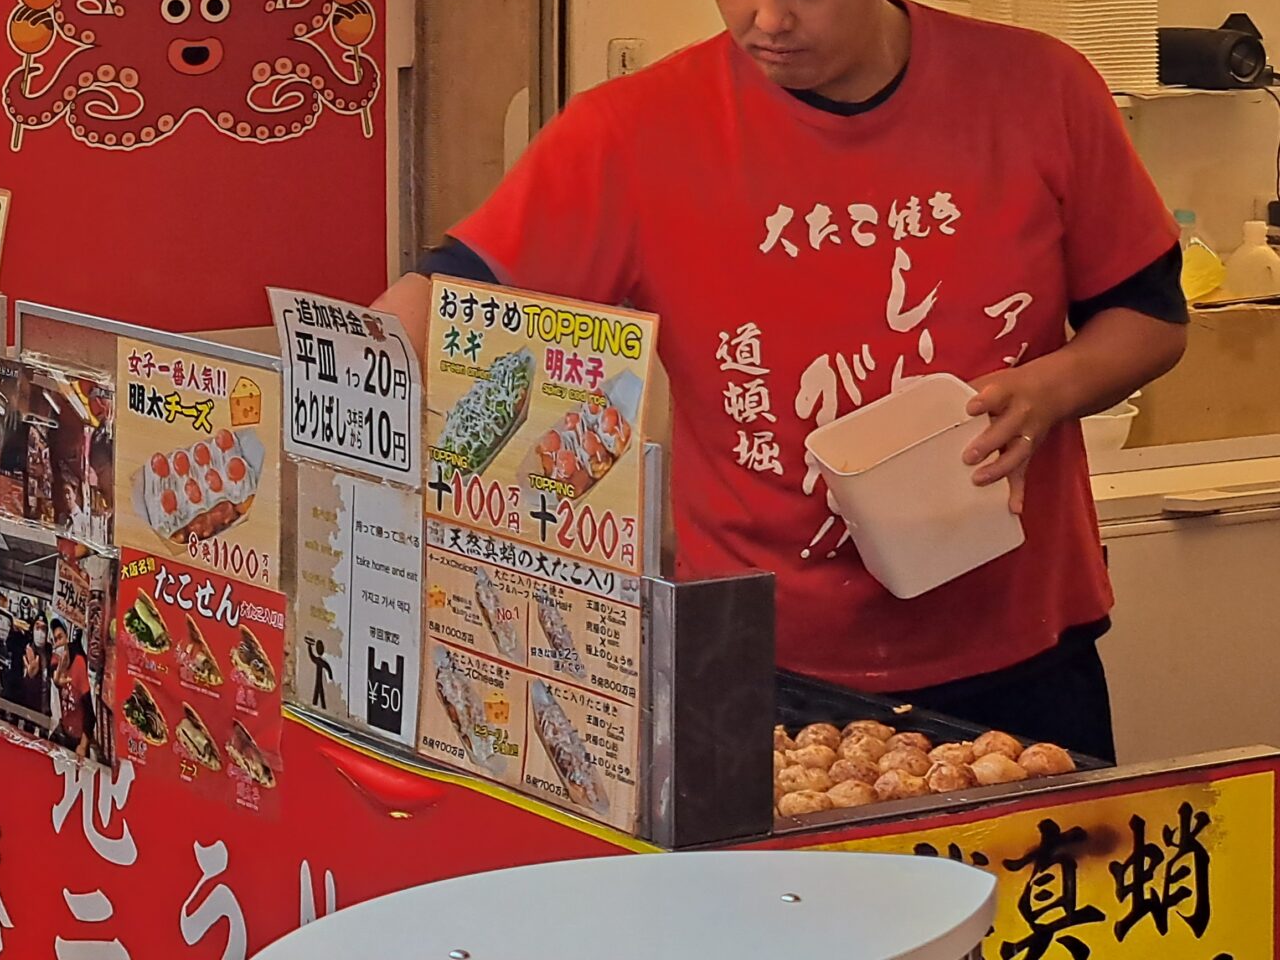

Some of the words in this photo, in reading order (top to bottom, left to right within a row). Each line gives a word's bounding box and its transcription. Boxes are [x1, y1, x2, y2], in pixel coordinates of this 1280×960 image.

[758, 191, 962, 258] 大たこ焼き
[294, 298, 366, 337] 追加料金
[439, 288, 521, 332] おすすめ
[523, 304, 643, 359] TOPPING
[295, 331, 338, 384] 平皿
[364, 347, 407, 400] 20円
[443, 325, 483, 363] ネギ
[545, 347, 605, 389] 明太子
[128, 349, 227, 395] 女子一番人気!!
[128, 383, 214, 434] 明太チーズ
[715, 321, 784, 476] 道頓堀
[295, 388, 346, 446] わりばし
[365, 407, 406, 463] 10円
[429, 445, 468, 469] TOPPING
[528, 473, 575, 498] TOPPING
[356, 555, 370, 569] take
[371, 560, 389, 574] home
[391, 566, 405, 579] and
[406, 569, 418, 582] eat
[449, 527, 614, 595] 天然真蛸の大たこ入り
[154, 564, 240, 627] たこせん
[368, 680, 401, 713] ¥50
[1002, 802, 1212, 960] 真蛸
